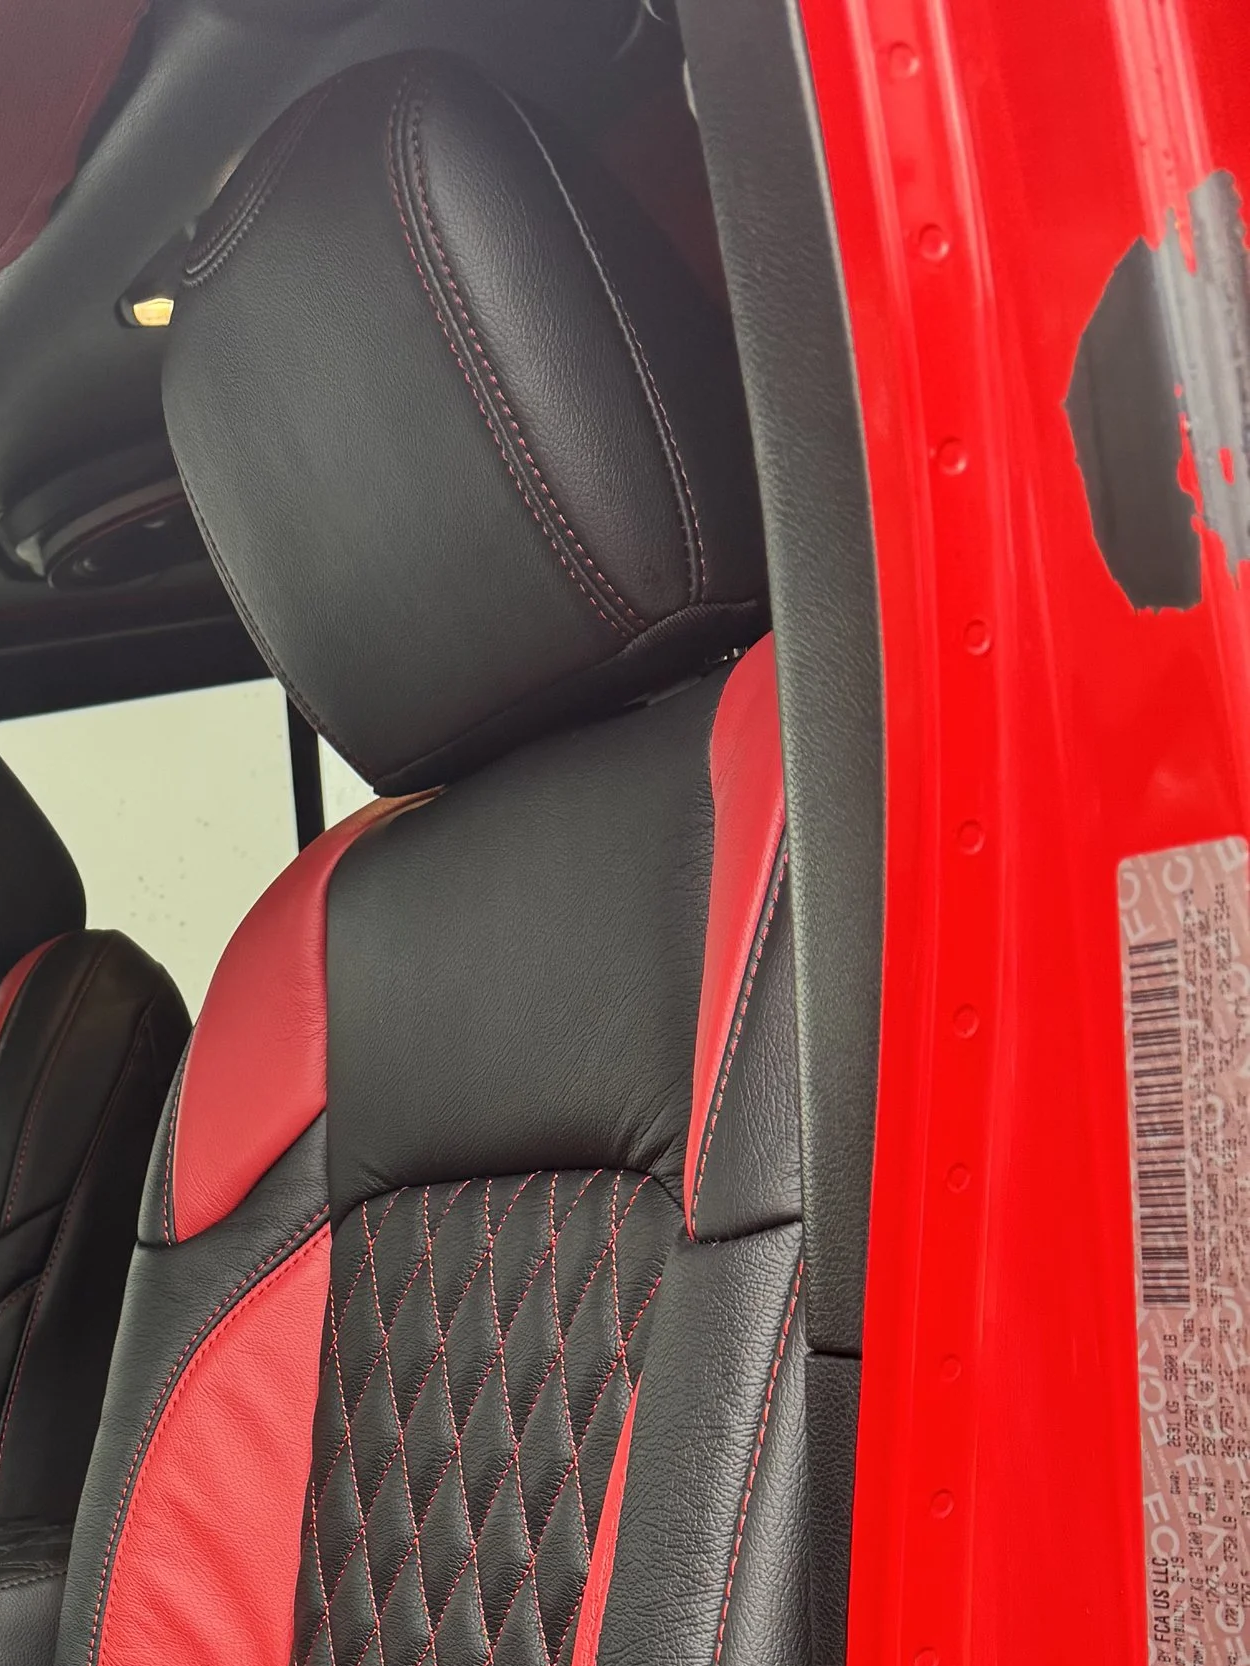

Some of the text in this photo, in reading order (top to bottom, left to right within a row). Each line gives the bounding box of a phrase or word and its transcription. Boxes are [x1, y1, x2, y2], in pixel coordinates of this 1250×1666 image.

[1163, 1334, 1177, 1348] LB
[1166, 1401, 1178, 1414] KG
[1188, 1512, 1201, 1526] LB
[1151, 1558, 1169, 1583] LLC
[1190, 1577, 1203, 1591] KG
[1153, 1589, 1169, 1610] US
[1154, 1616, 1170, 1642] FCA
[1158, 1649, 1170, 1662] BY
